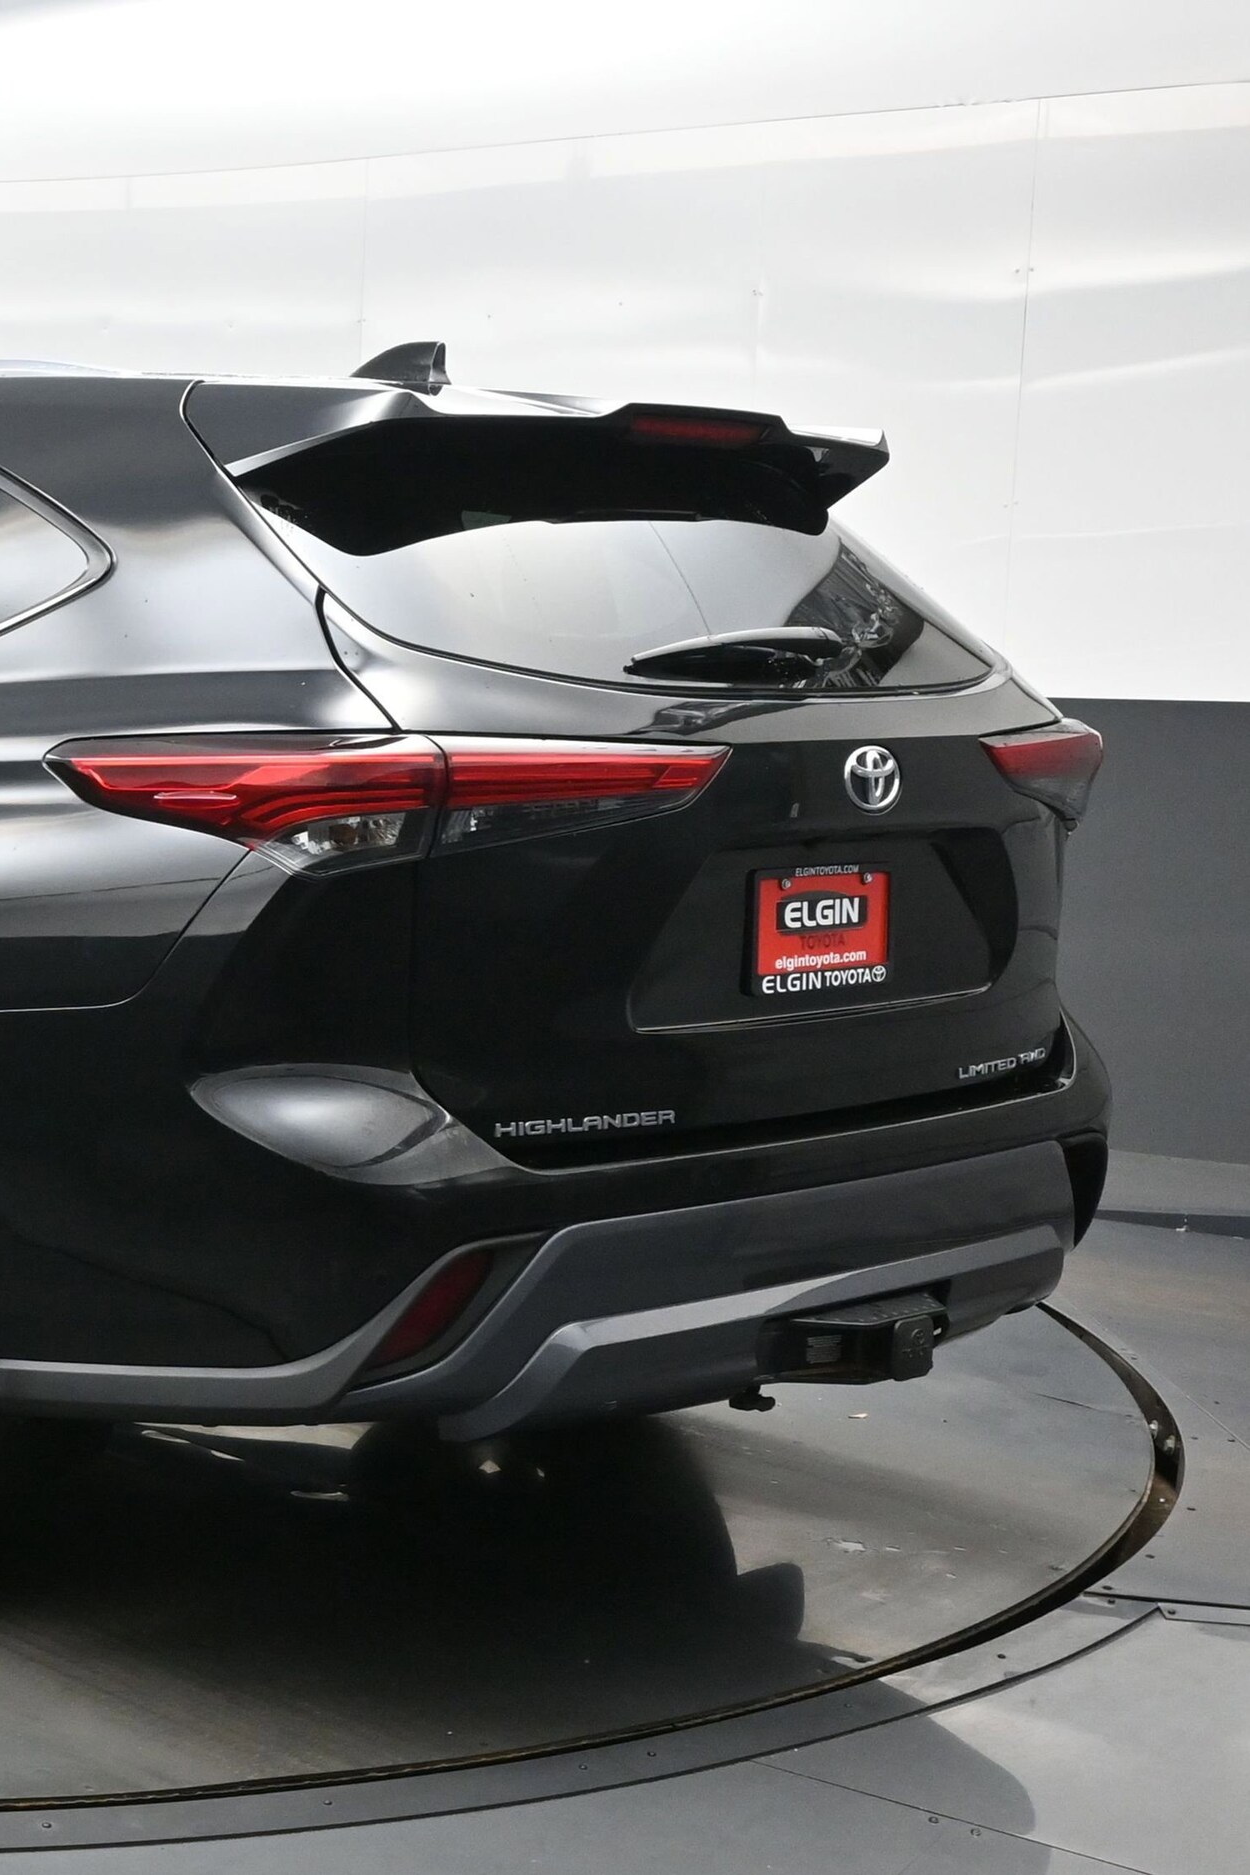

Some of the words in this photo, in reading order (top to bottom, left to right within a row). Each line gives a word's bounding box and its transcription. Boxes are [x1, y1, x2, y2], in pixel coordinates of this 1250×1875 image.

[795, 864, 859, 877] ELGINTOYOTA.COM
[784, 897, 859, 928] ELGIN
[800, 934, 845, 950] TOYOTA
[775, 950, 866, 971] elgintoyota.com
[762, 973, 822, 994] ELGIN
[824, 967, 872, 986] TOYOTA
[958, 1057, 1017, 1079] LIMITED
[494, 1110, 675, 1138] HIGHLANDER
